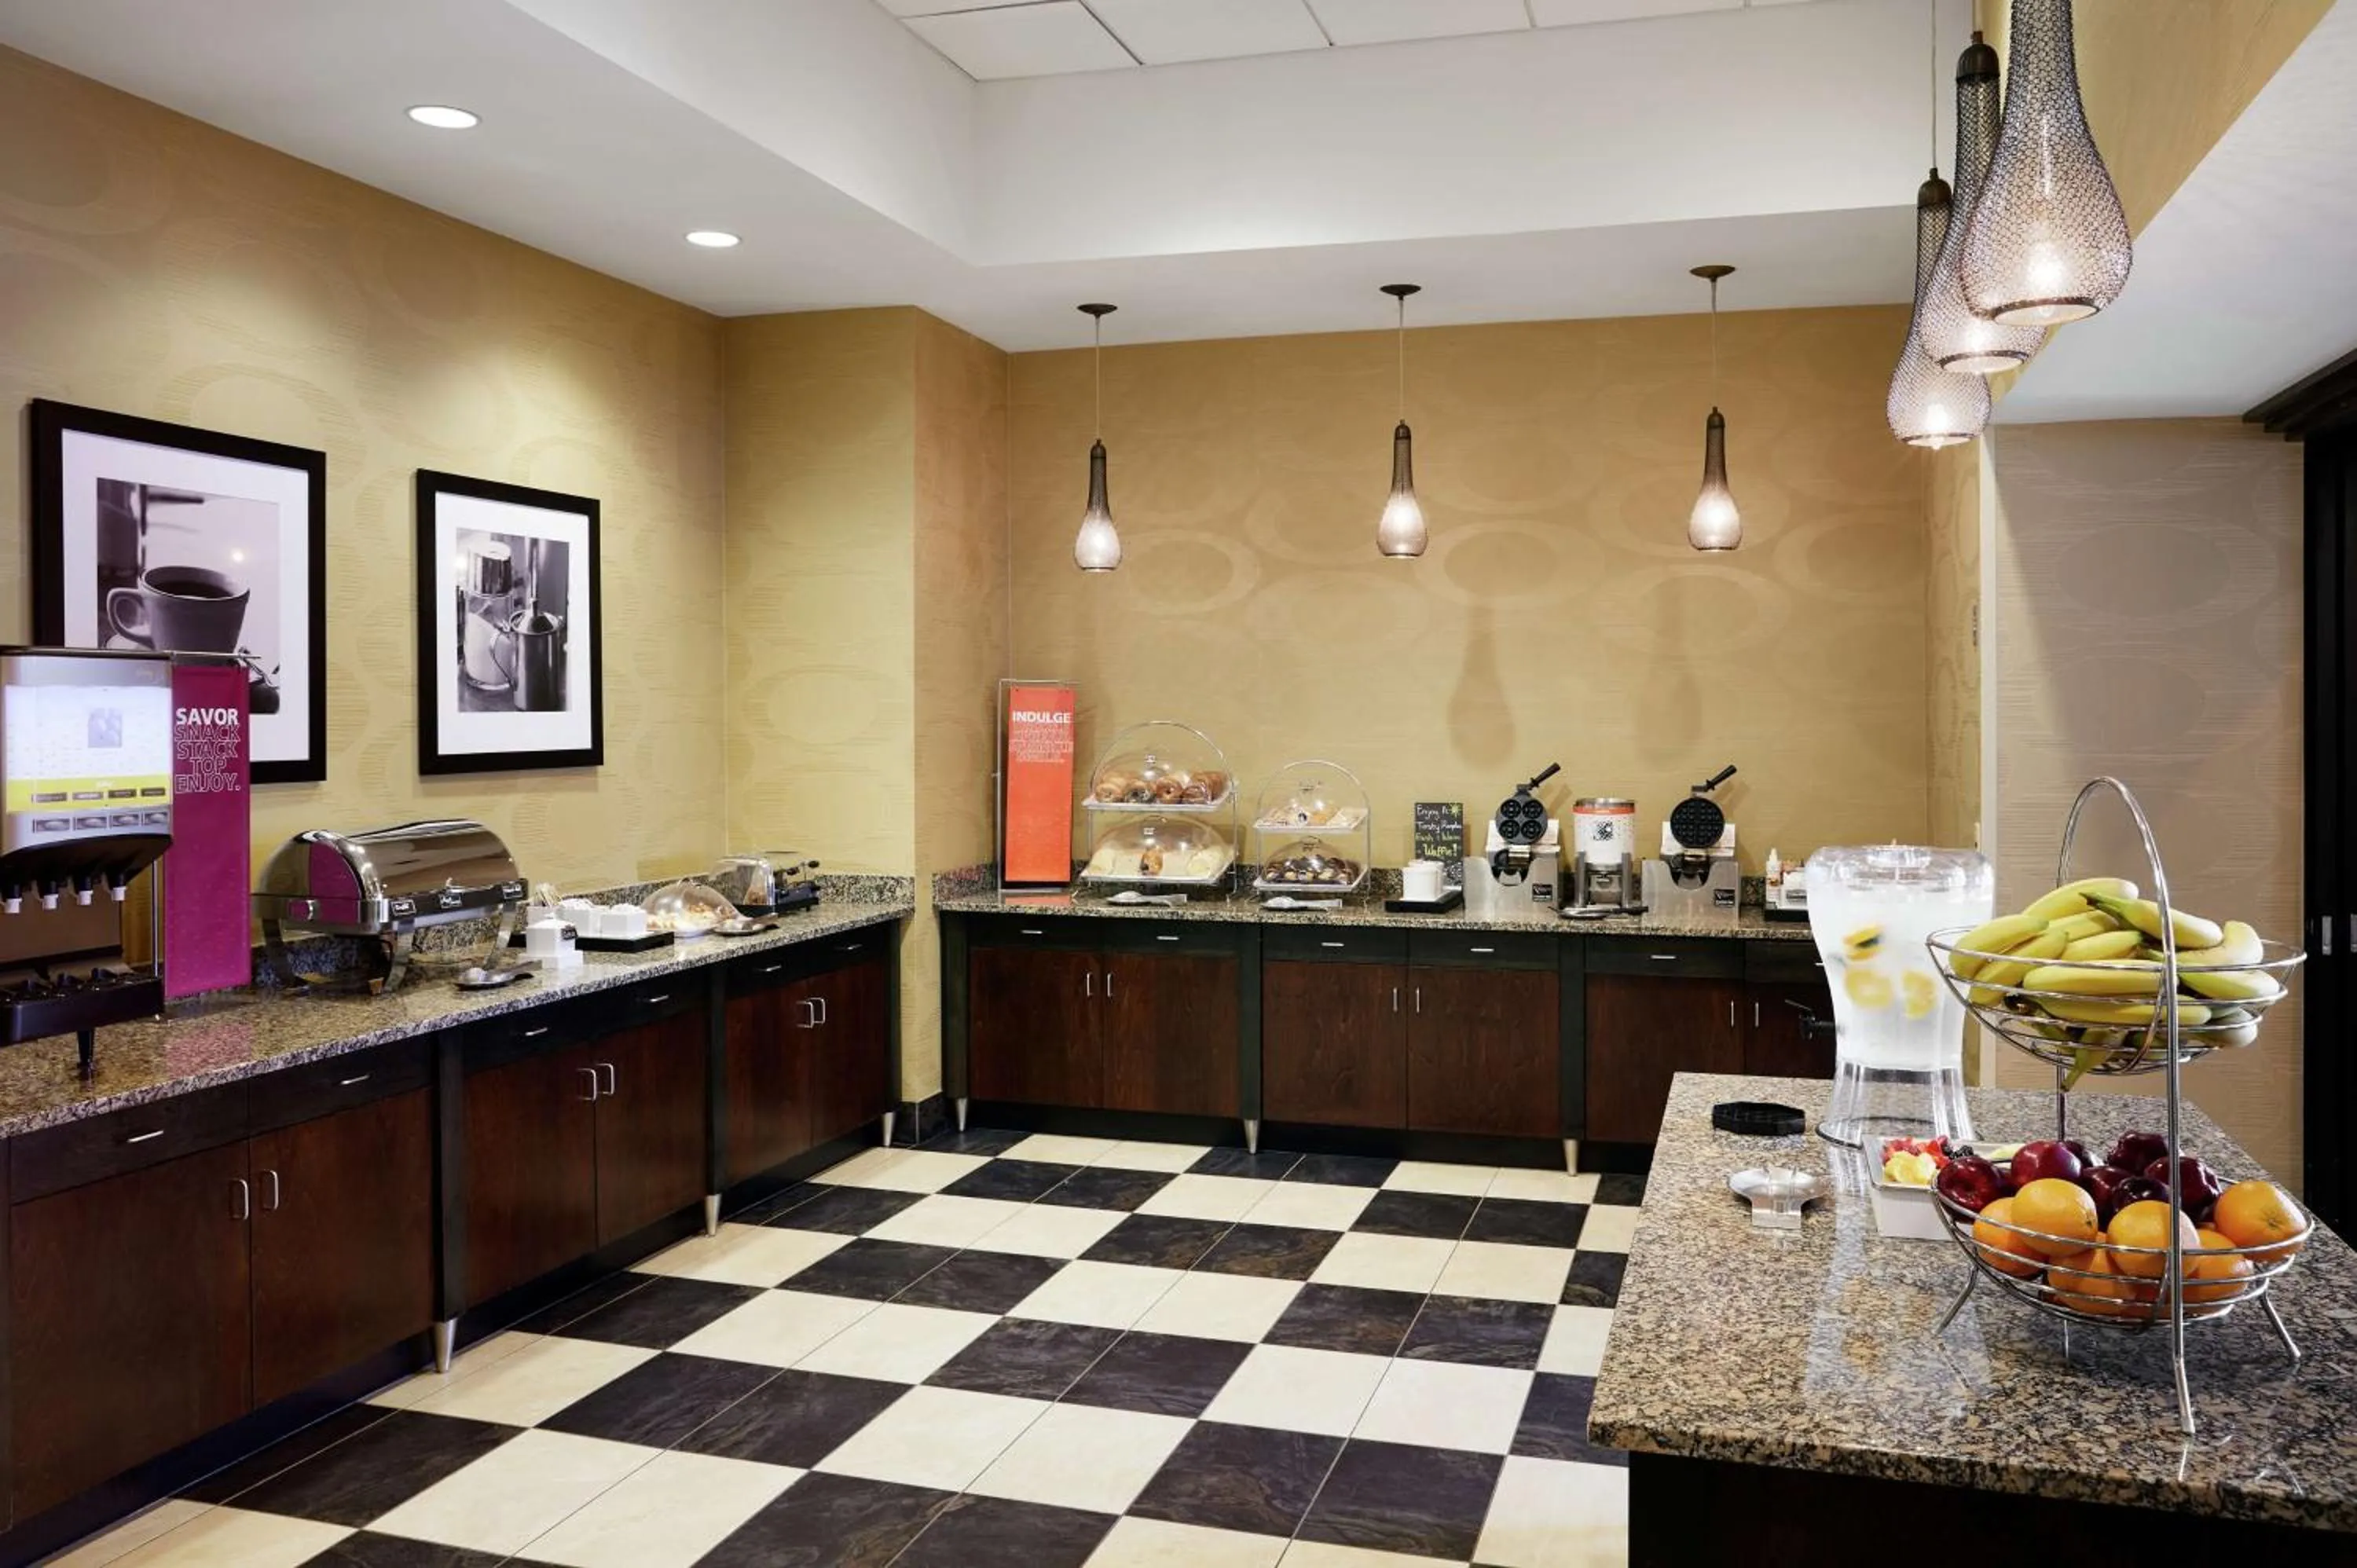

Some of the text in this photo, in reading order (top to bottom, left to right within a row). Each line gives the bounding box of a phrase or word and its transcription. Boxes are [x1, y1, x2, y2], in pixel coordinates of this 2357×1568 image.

[175, 707, 239, 725] SAVOR
[1012, 709, 1072, 724] INDULGE
[174, 724, 240, 742] SNACK
[177, 741, 238, 760] STACK
[189, 757, 227, 775] TOP
[174, 773, 241, 793] ENJOY.
